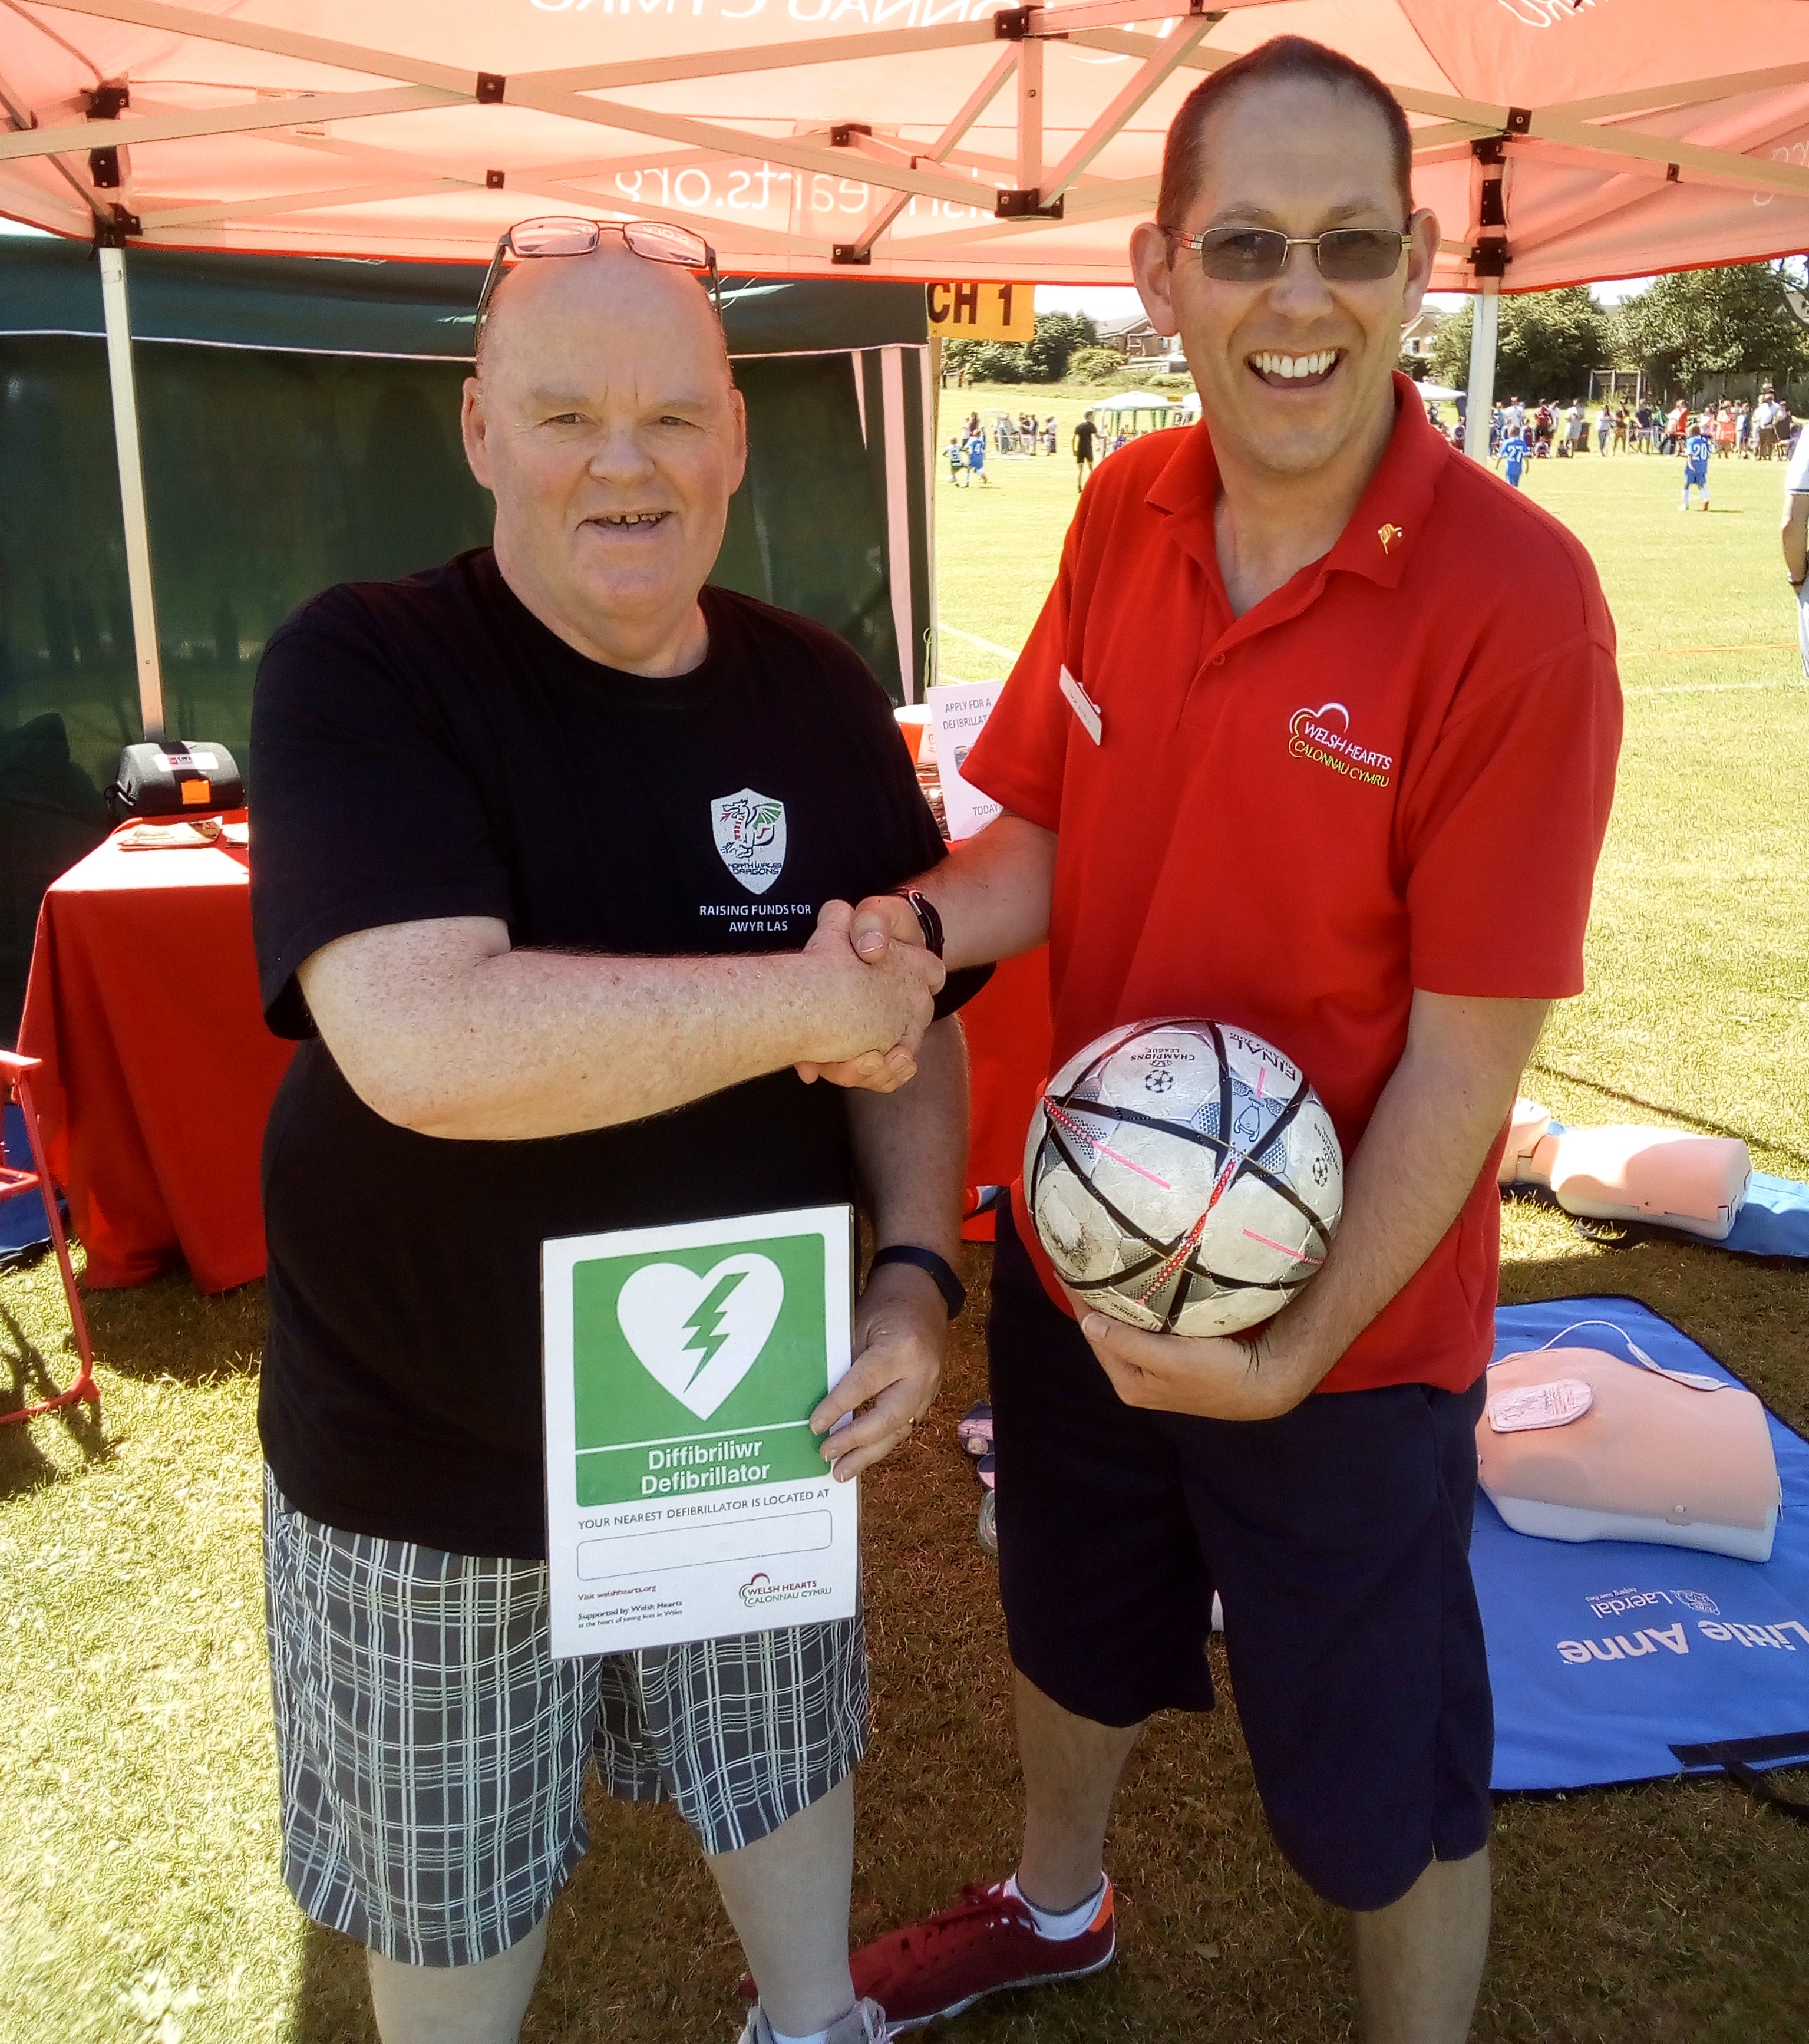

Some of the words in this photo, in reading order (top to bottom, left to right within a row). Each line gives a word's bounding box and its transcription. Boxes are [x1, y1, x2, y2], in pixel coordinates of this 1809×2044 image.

[998, 284, 1012, 326] 1
[1507, 444, 1524, 463] 27
[1692, 443, 1708, 460] 20
[945, 701, 967, 713] APPLY
[969, 698, 985, 710] FOR
[986, 698, 992, 707] A
[1304, 721, 1348, 752] WELSH
[1344, 742, 1392, 770] HEARTS
[1294, 740, 1350, 775] CALONNAU
[1349, 767, 1390, 787] CYMRU
[972, 803, 998, 816] TODAY
[699, 905, 748, 916] RAISING
[751, 904, 789, 916] FUNDS
[791, 904, 811, 914] FOR
[728, 921, 764, 932] AWYR
[767, 921, 788, 931] LAS
[1130, 1053, 1196, 1061] CHAMPIONS
[1229, 1036, 1296, 1082] FINAL
[648, 1440, 762, 1471] Diffibriliwr
[641, 1463, 771, 1495] Defibrillator
[578, 1518, 610, 1530] YOUR
[614, 1510, 662, 1525] NEAREST
[667, 1499, 748, 1519] DEFIBRILLATOR
[752, 1498, 761, 1507] IS
[764, 1491, 814, 1506] LOCATED
[817, 1489, 831, 1498] AT
[578, 1593, 595, 1601] Visit
[596, 1585, 656, 1598] welshhearts.org
[748, 1585, 780, 1595] WELSH
[782, 1580, 817, 1592] HEARTS
[748, 1591, 799, 1605] CALONNAU
[801, 1587, 832, 1598] CYMRU
[578, 1608, 619, 1620] Supported
[656, 1601, 682, 1609] Hearts
[1590, 1591, 1674, 1619] Laerdal
[1697, 1620, 1809, 1651] Little
